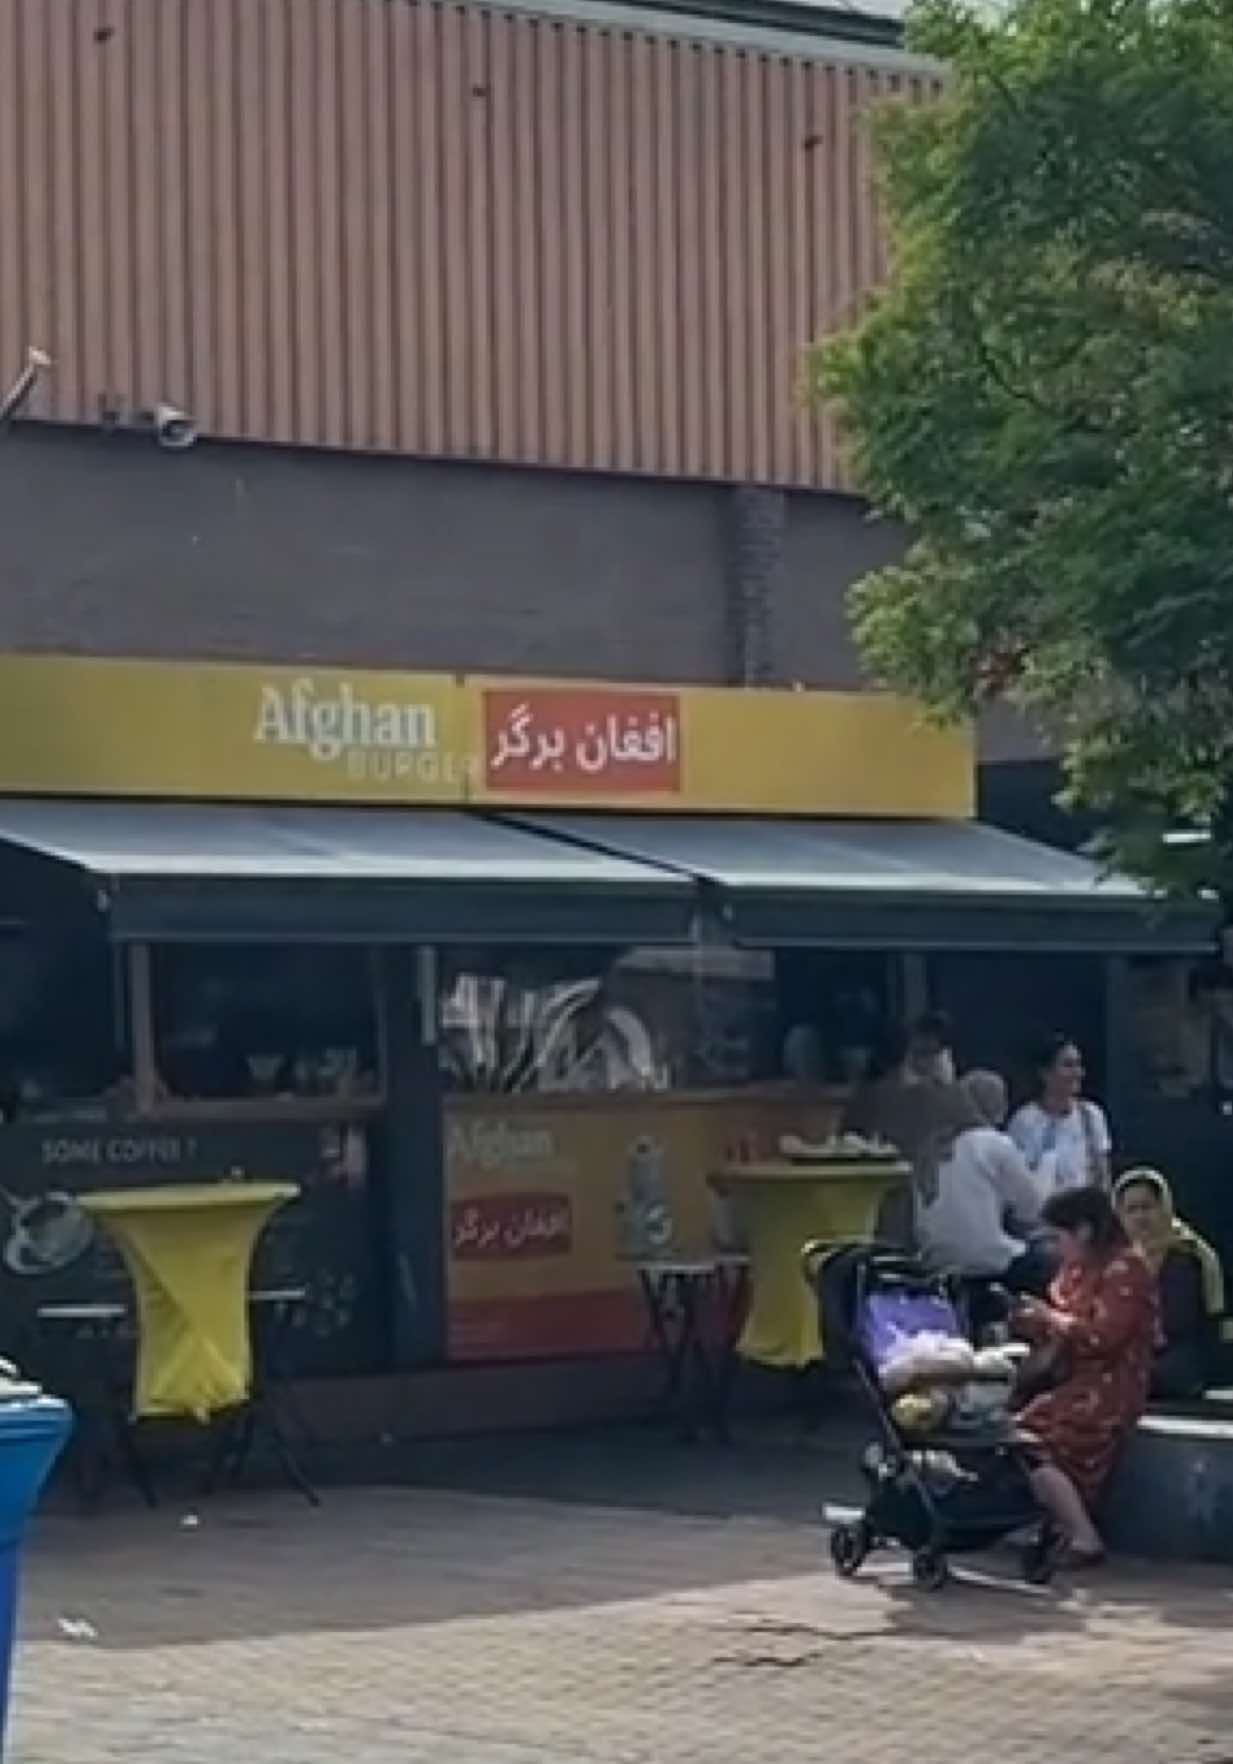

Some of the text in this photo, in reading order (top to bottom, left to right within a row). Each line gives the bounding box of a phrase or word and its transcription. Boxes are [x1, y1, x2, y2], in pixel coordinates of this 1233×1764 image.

[253, 679, 436, 760] Afghan
[490, 703, 676, 772] افغان برگر
